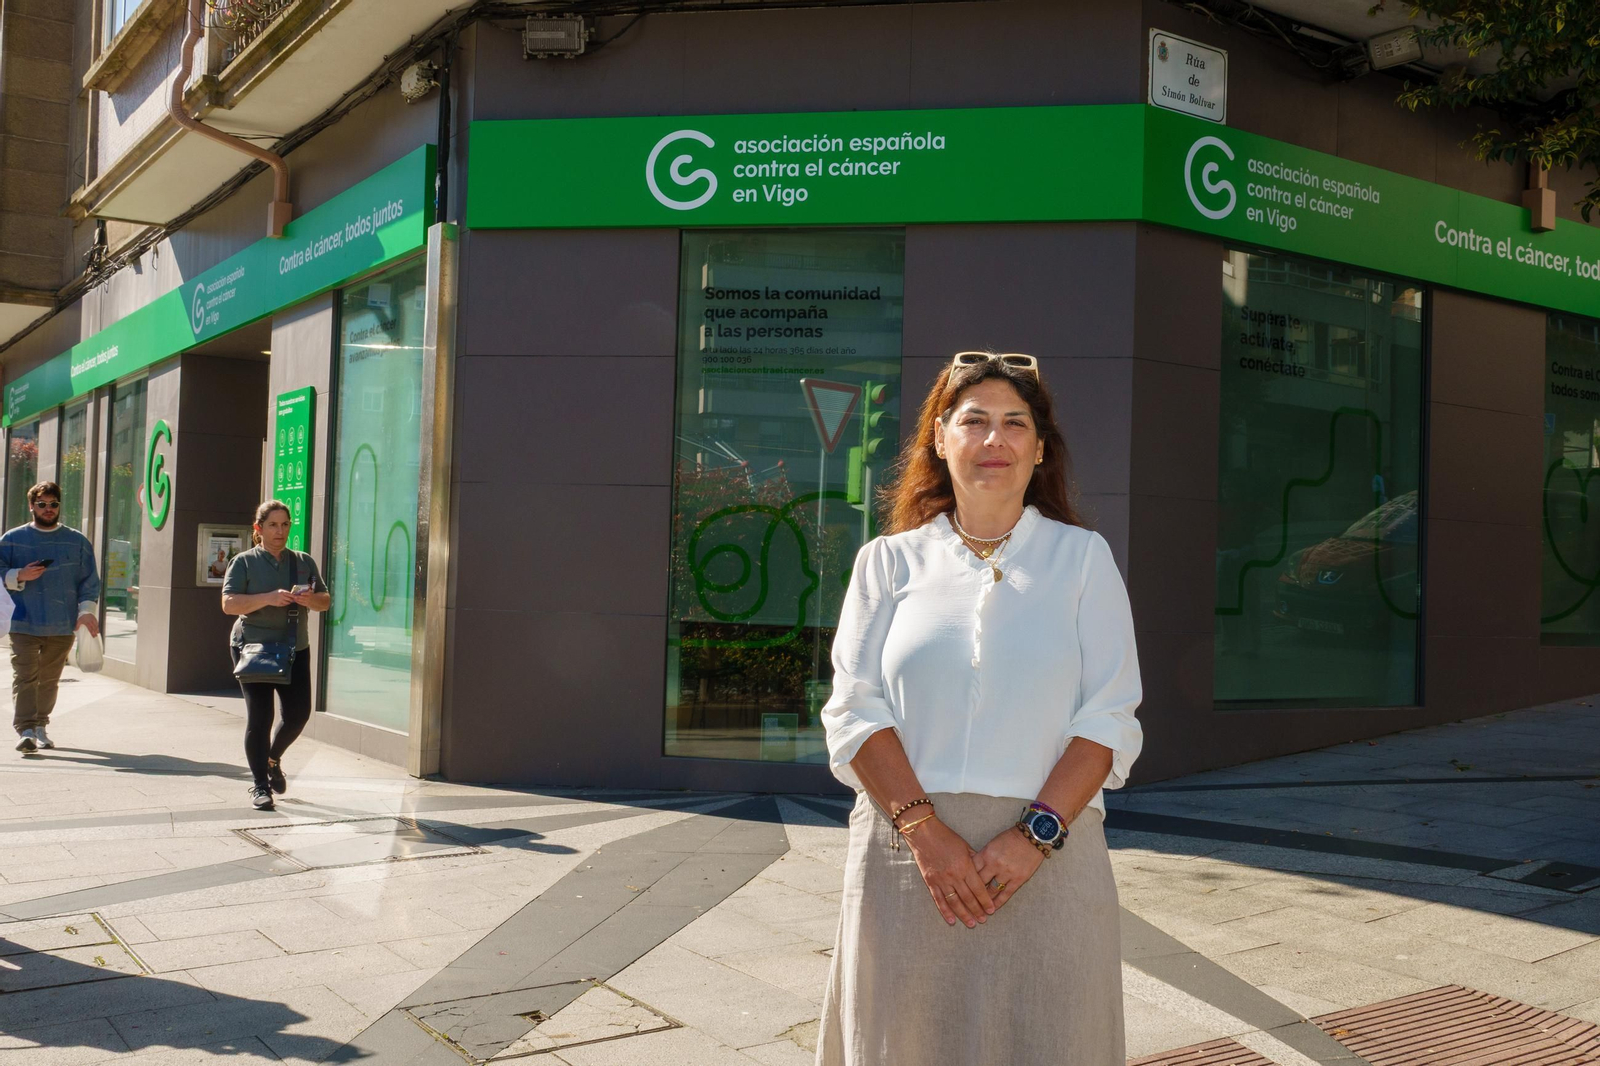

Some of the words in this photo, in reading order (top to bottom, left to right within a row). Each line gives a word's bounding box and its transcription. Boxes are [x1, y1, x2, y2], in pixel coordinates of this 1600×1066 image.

[1186, 53, 1205, 69] Rúa
[1188, 74, 1199, 87] de
[1162, 85, 1185, 101] Simón
[1189, 93, 1215, 109] Bolívar
[734, 134, 843, 154] asociación
[849, 131, 945, 155] española
[733, 161, 799, 178] contra
[805, 159, 822, 176] el
[828, 155, 901, 176] cáncer
[1248, 158, 1318, 188] asociación
[1323, 178, 1380, 204] española
[732, 188, 757, 202] en
[762, 184, 808, 206] Vigo
[1247, 183, 1291, 205] contra
[1294, 192, 1306, 208] el
[1309, 196, 1354, 220] cáncer
[1246, 207, 1263, 222] en
[1267, 207, 1297, 233] Vigo
[279, 250, 304, 275] Contra
[305, 240, 312, 262] el
[314, 230, 343, 258] cáncer,
[345, 215, 371, 242] todos
[371, 199, 403, 235] juntos
[1435, 220, 1492, 255] Contra
[1496, 237, 1512, 260] el
[1515, 242, 1572, 277] cáncer,
[705, 287, 761, 300] Somos
[765, 287, 780, 300] la
[785, 286, 881, 300] comunidad
[704, 308, 736, 321] que
[740, 305, 828, 322] acompaña
[705, 327, 712, 337] a
[718, 324, 741, 337] las
[746, 327, 823, 341] personas
[702, 356, 718, 365] 900
[736, 356, 752, 365] 036
[719, 346, 737, 354] lado
[739, 346, 753, 354] las
[753, 347, 763, 355] 24
[790, 347, 804, 356] 365
[825, 347, 839, 355] del
[841, 347, 856, 355] año
[1240, 356, 1305, 377] conéctate
[1551, 362, 1583, 379] Contra
[1585, 368, 1594, 381] el
[1551, 382, 1578, 398] todos
